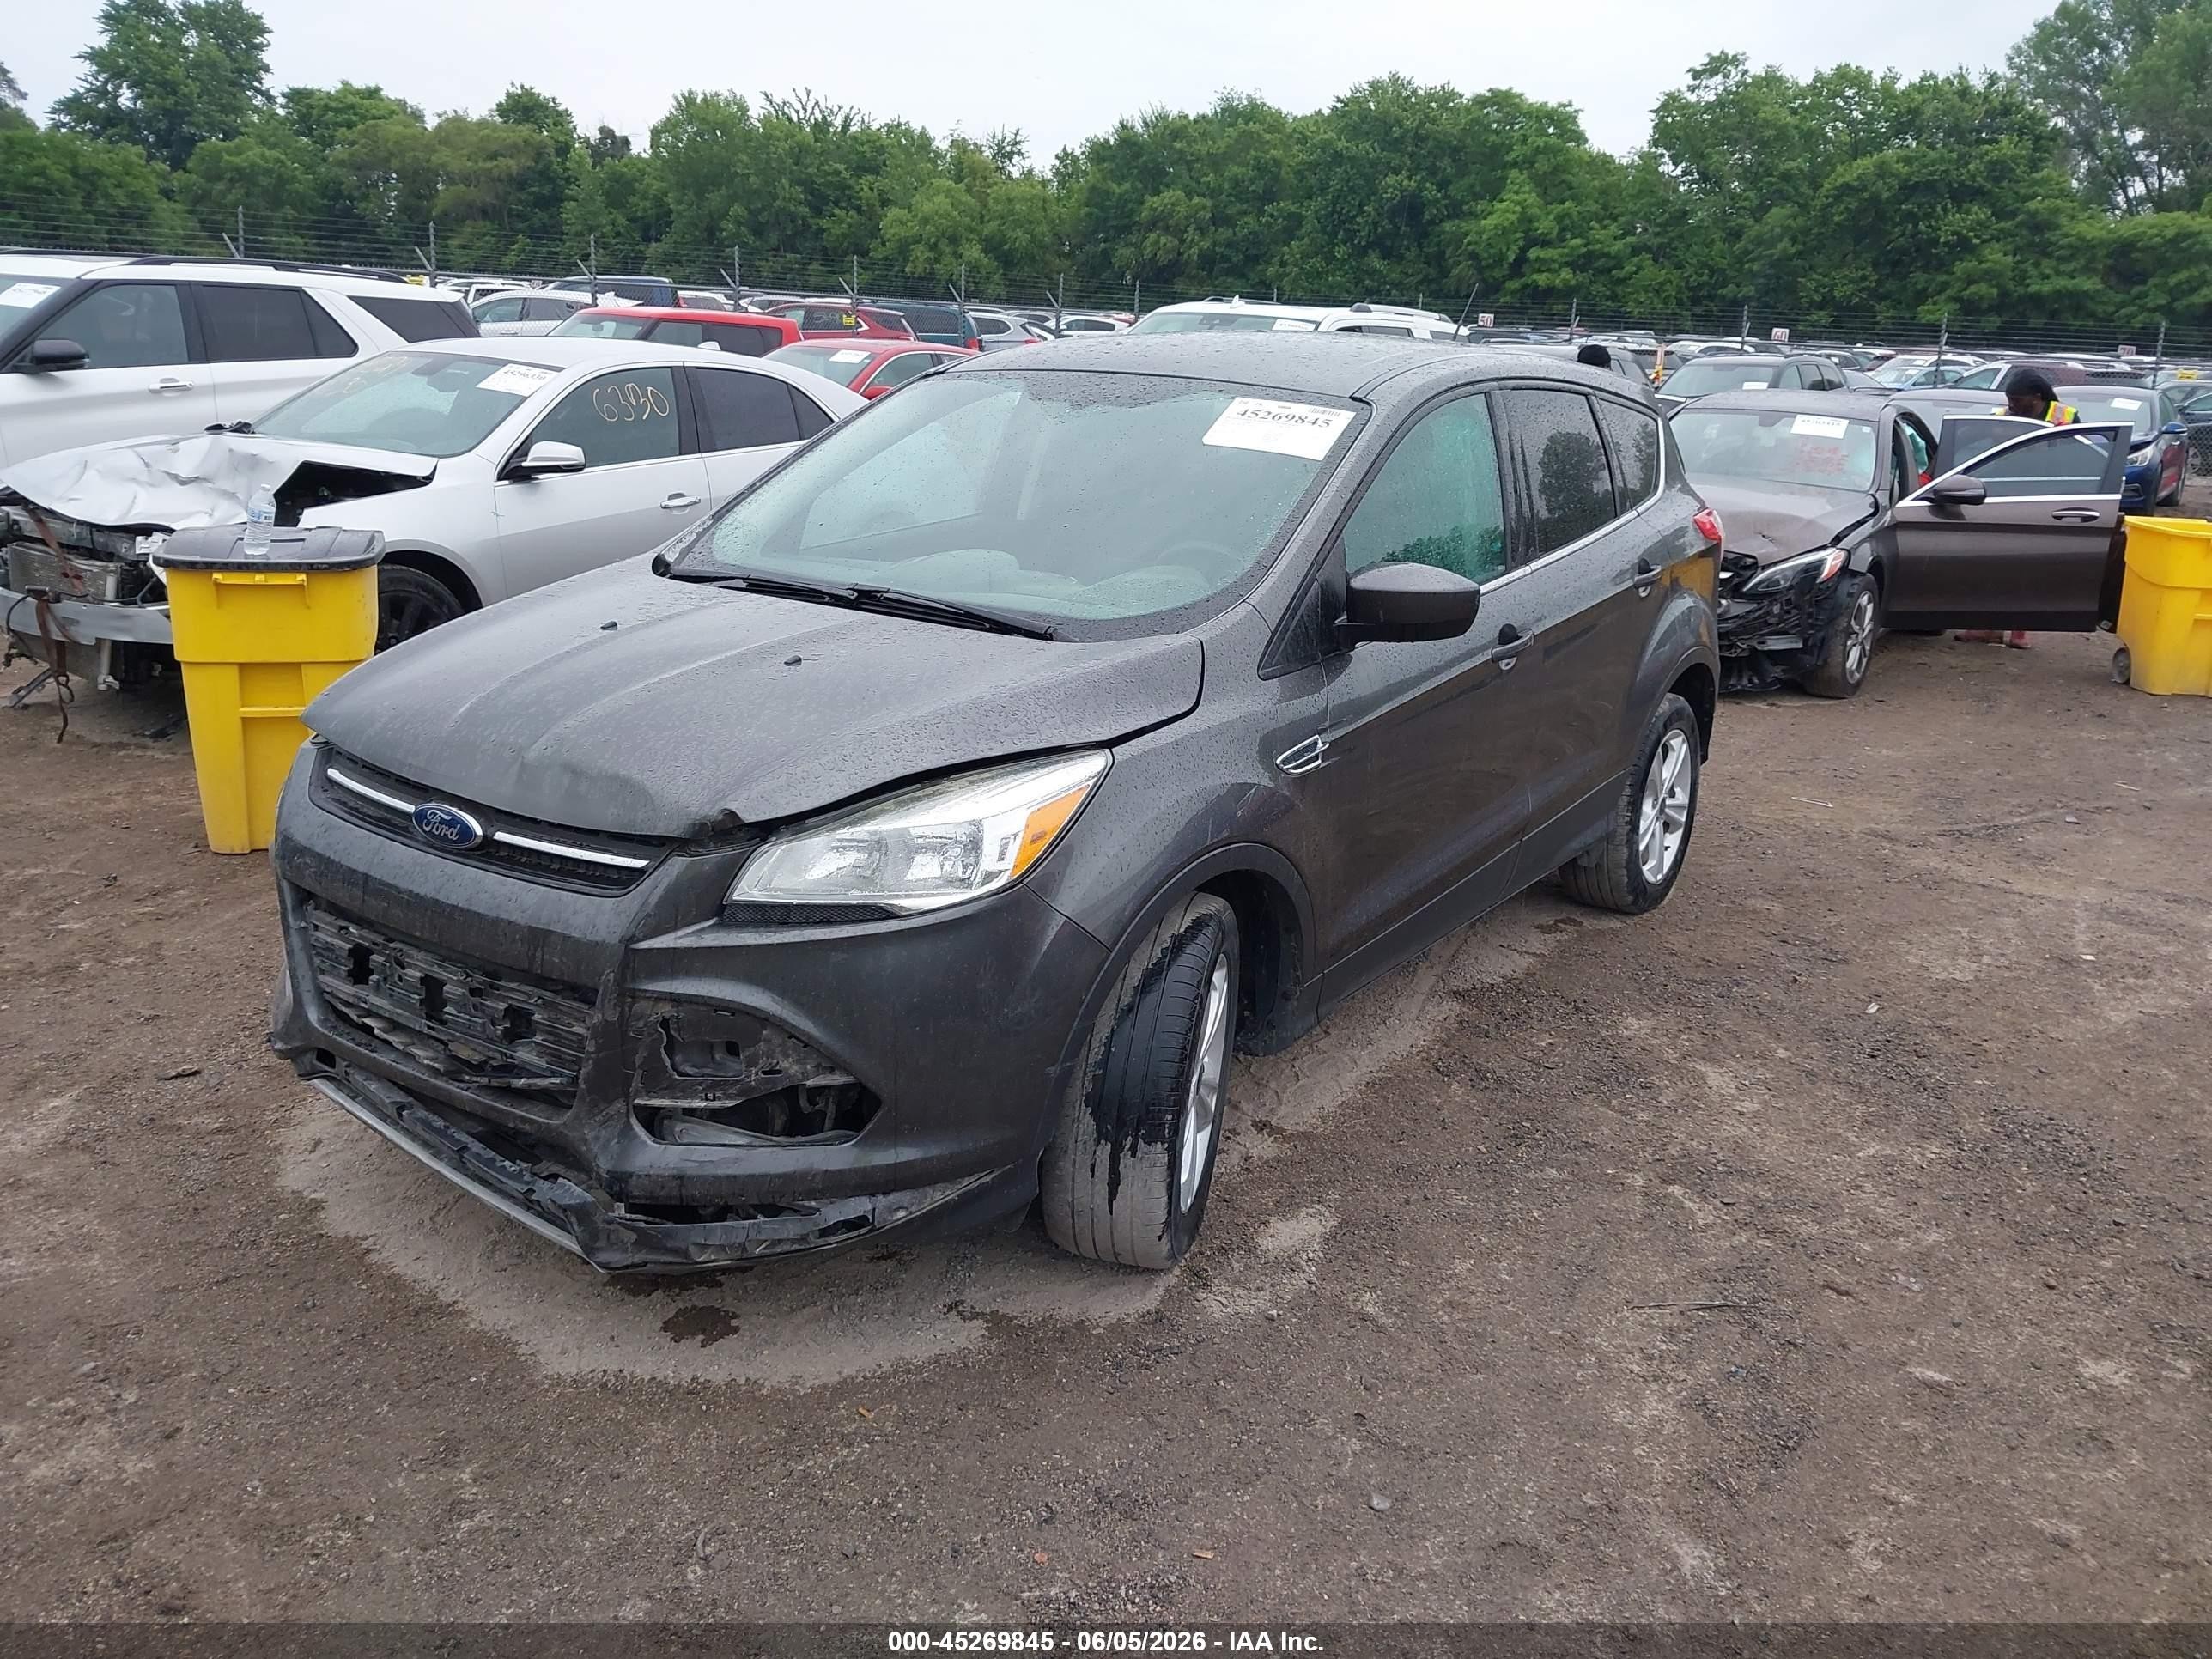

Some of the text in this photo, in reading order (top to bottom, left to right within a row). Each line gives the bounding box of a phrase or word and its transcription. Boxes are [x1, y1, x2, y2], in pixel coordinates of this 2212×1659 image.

[1480, 315, 1492, 326] 50
[1236, 408, 1334, 428] 45269845
[422, 810, 461, 841] Ford
